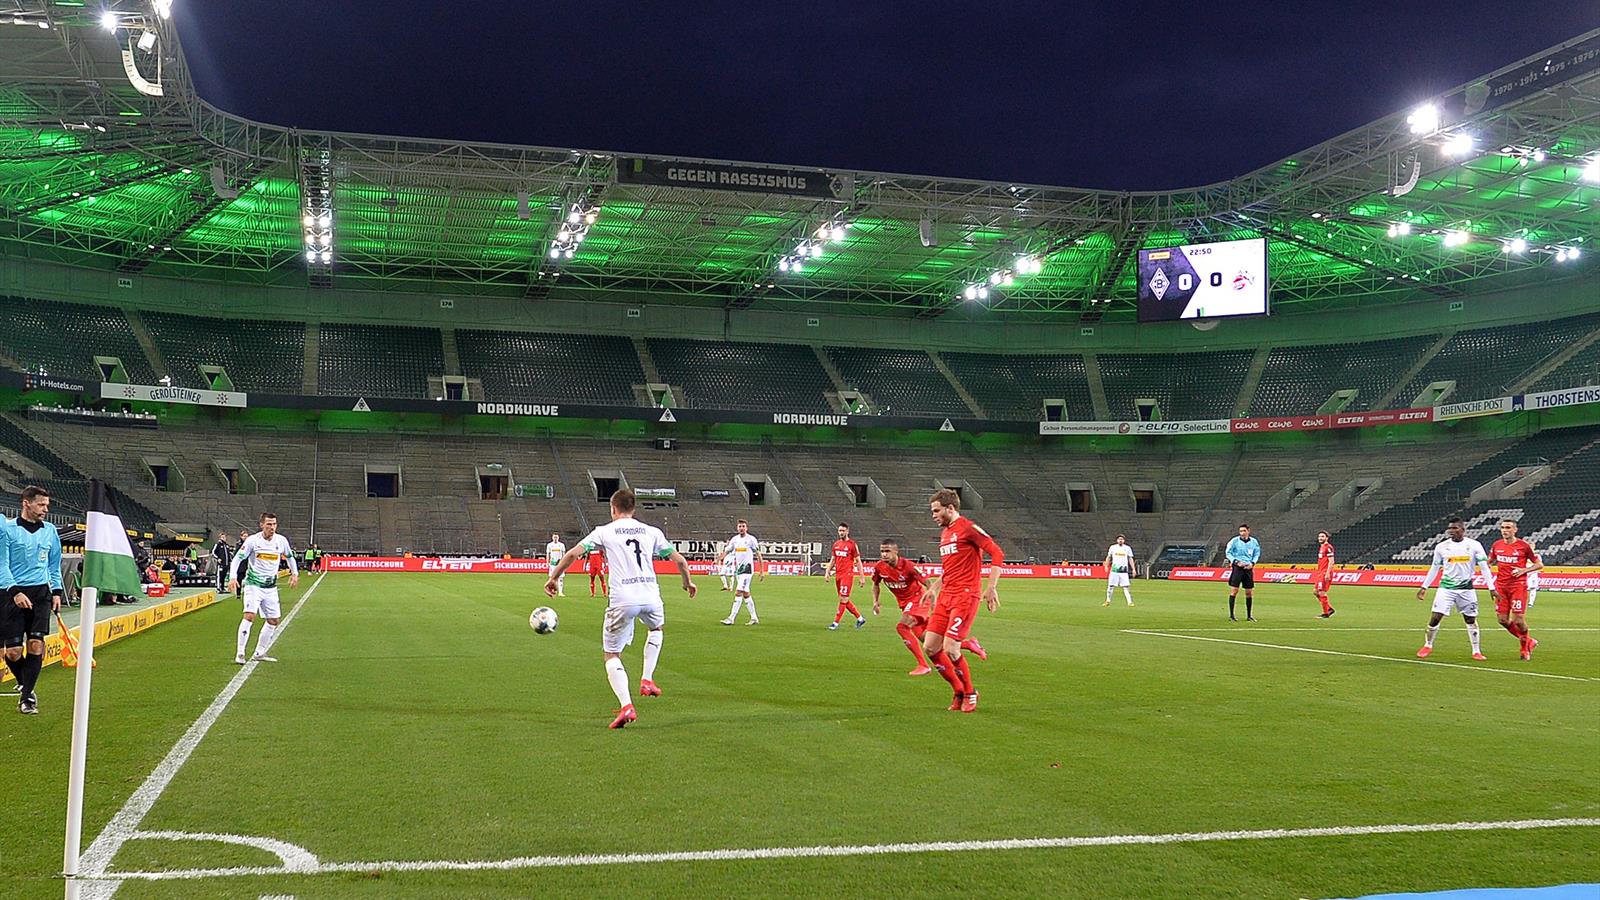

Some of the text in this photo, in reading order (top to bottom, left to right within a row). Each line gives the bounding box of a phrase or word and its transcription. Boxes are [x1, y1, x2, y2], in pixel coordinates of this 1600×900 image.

[667, 167, 807, 190] GEGEN RASSISMUS
[1189, 248, 1212, 256] 22:50
[1210, 272, 1222, 287] 0
[40, 379, 84, 392] H-Hotels.com
[149, 387, 202, 404] GEROLSTEINER
[477, 402, 559, 416] NORDKURVE
[1440, 398, 1505, 416] RHEINISCHE POST
[773, 413, 848, 426] NORDKURVE
[1337, 416, 1364, 425] ELTEN
[1399, 411, 1428, 420] ELTEN
[625, 538, 643, 572] 7
[422, 559, 472, 570] ELTEN
[1050, 567, 1092, 577] ELTEN
[950, 616, 963, 632] 2
